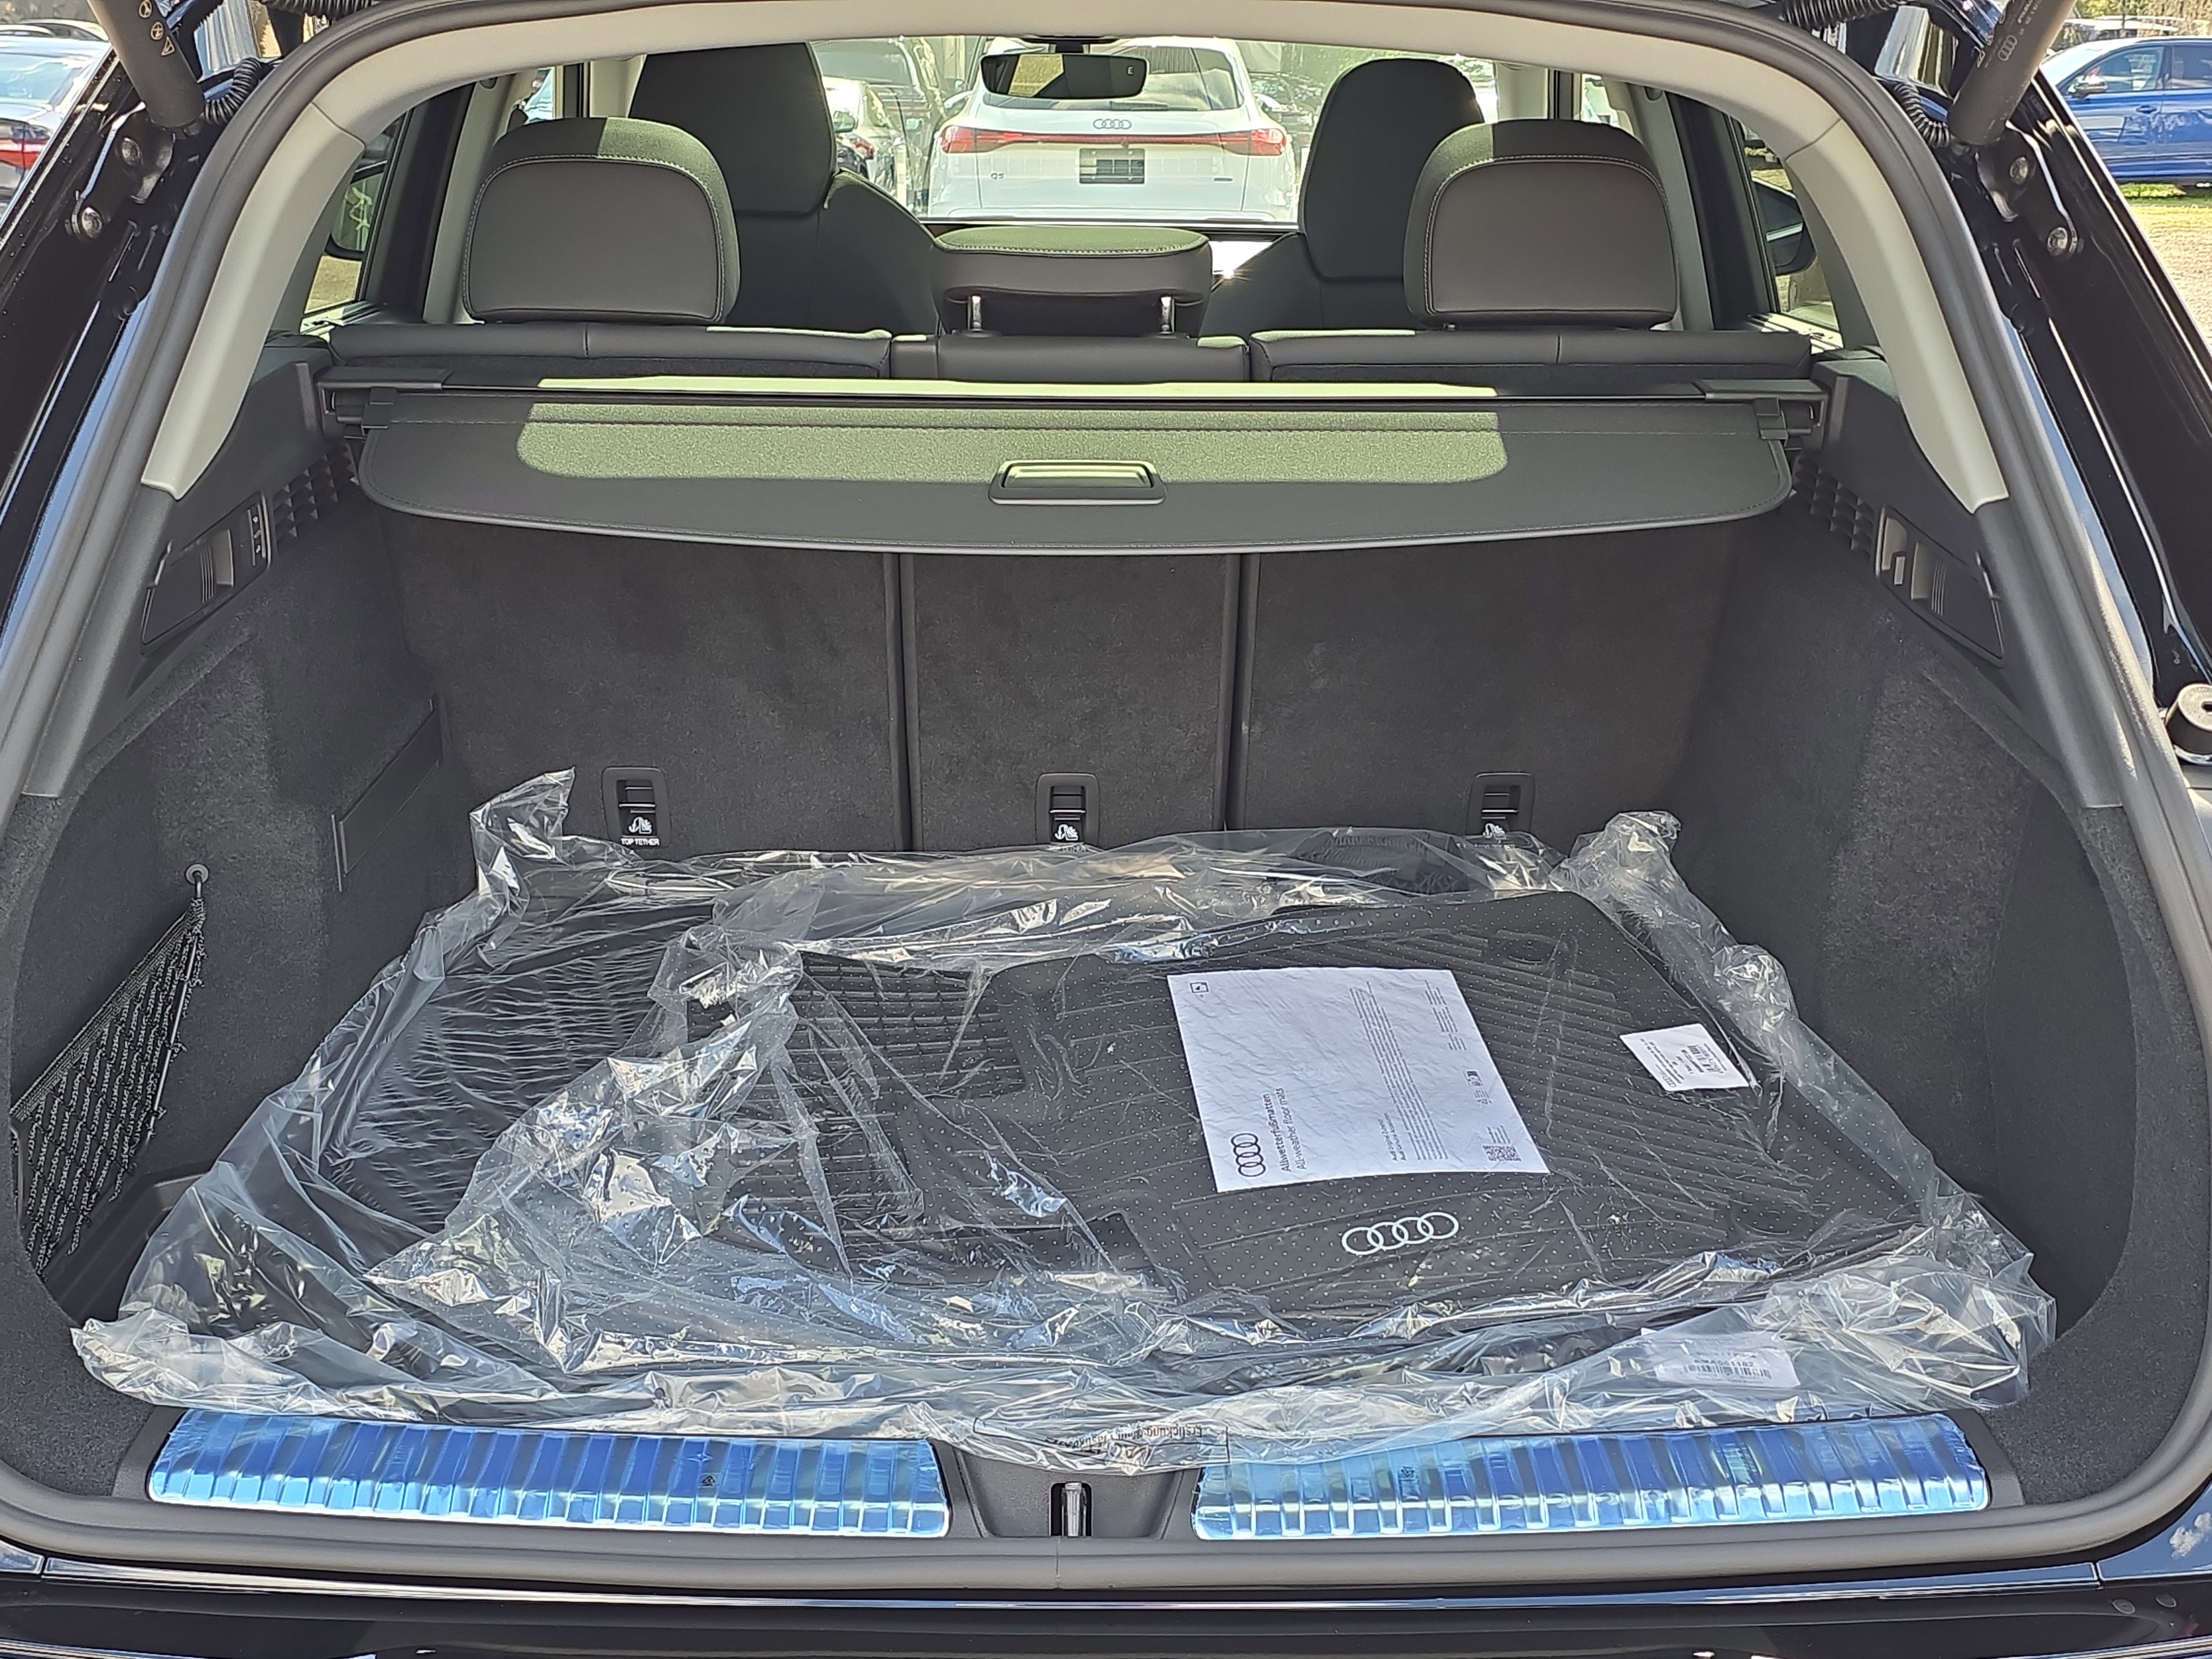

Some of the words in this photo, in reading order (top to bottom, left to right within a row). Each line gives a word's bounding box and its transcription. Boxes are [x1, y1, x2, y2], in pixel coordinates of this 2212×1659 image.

[1127, 66, 1134, 75] E
[634, 838, 660, 846] TETHER
[1275, 1087, 1288, 1105] mats
[1281, 1106, 1293, 1124] floor
[1263, 1094, 1291, 1172] Allwetterfußmatten
[1287, 1125, 1307, 1170] All-weather
